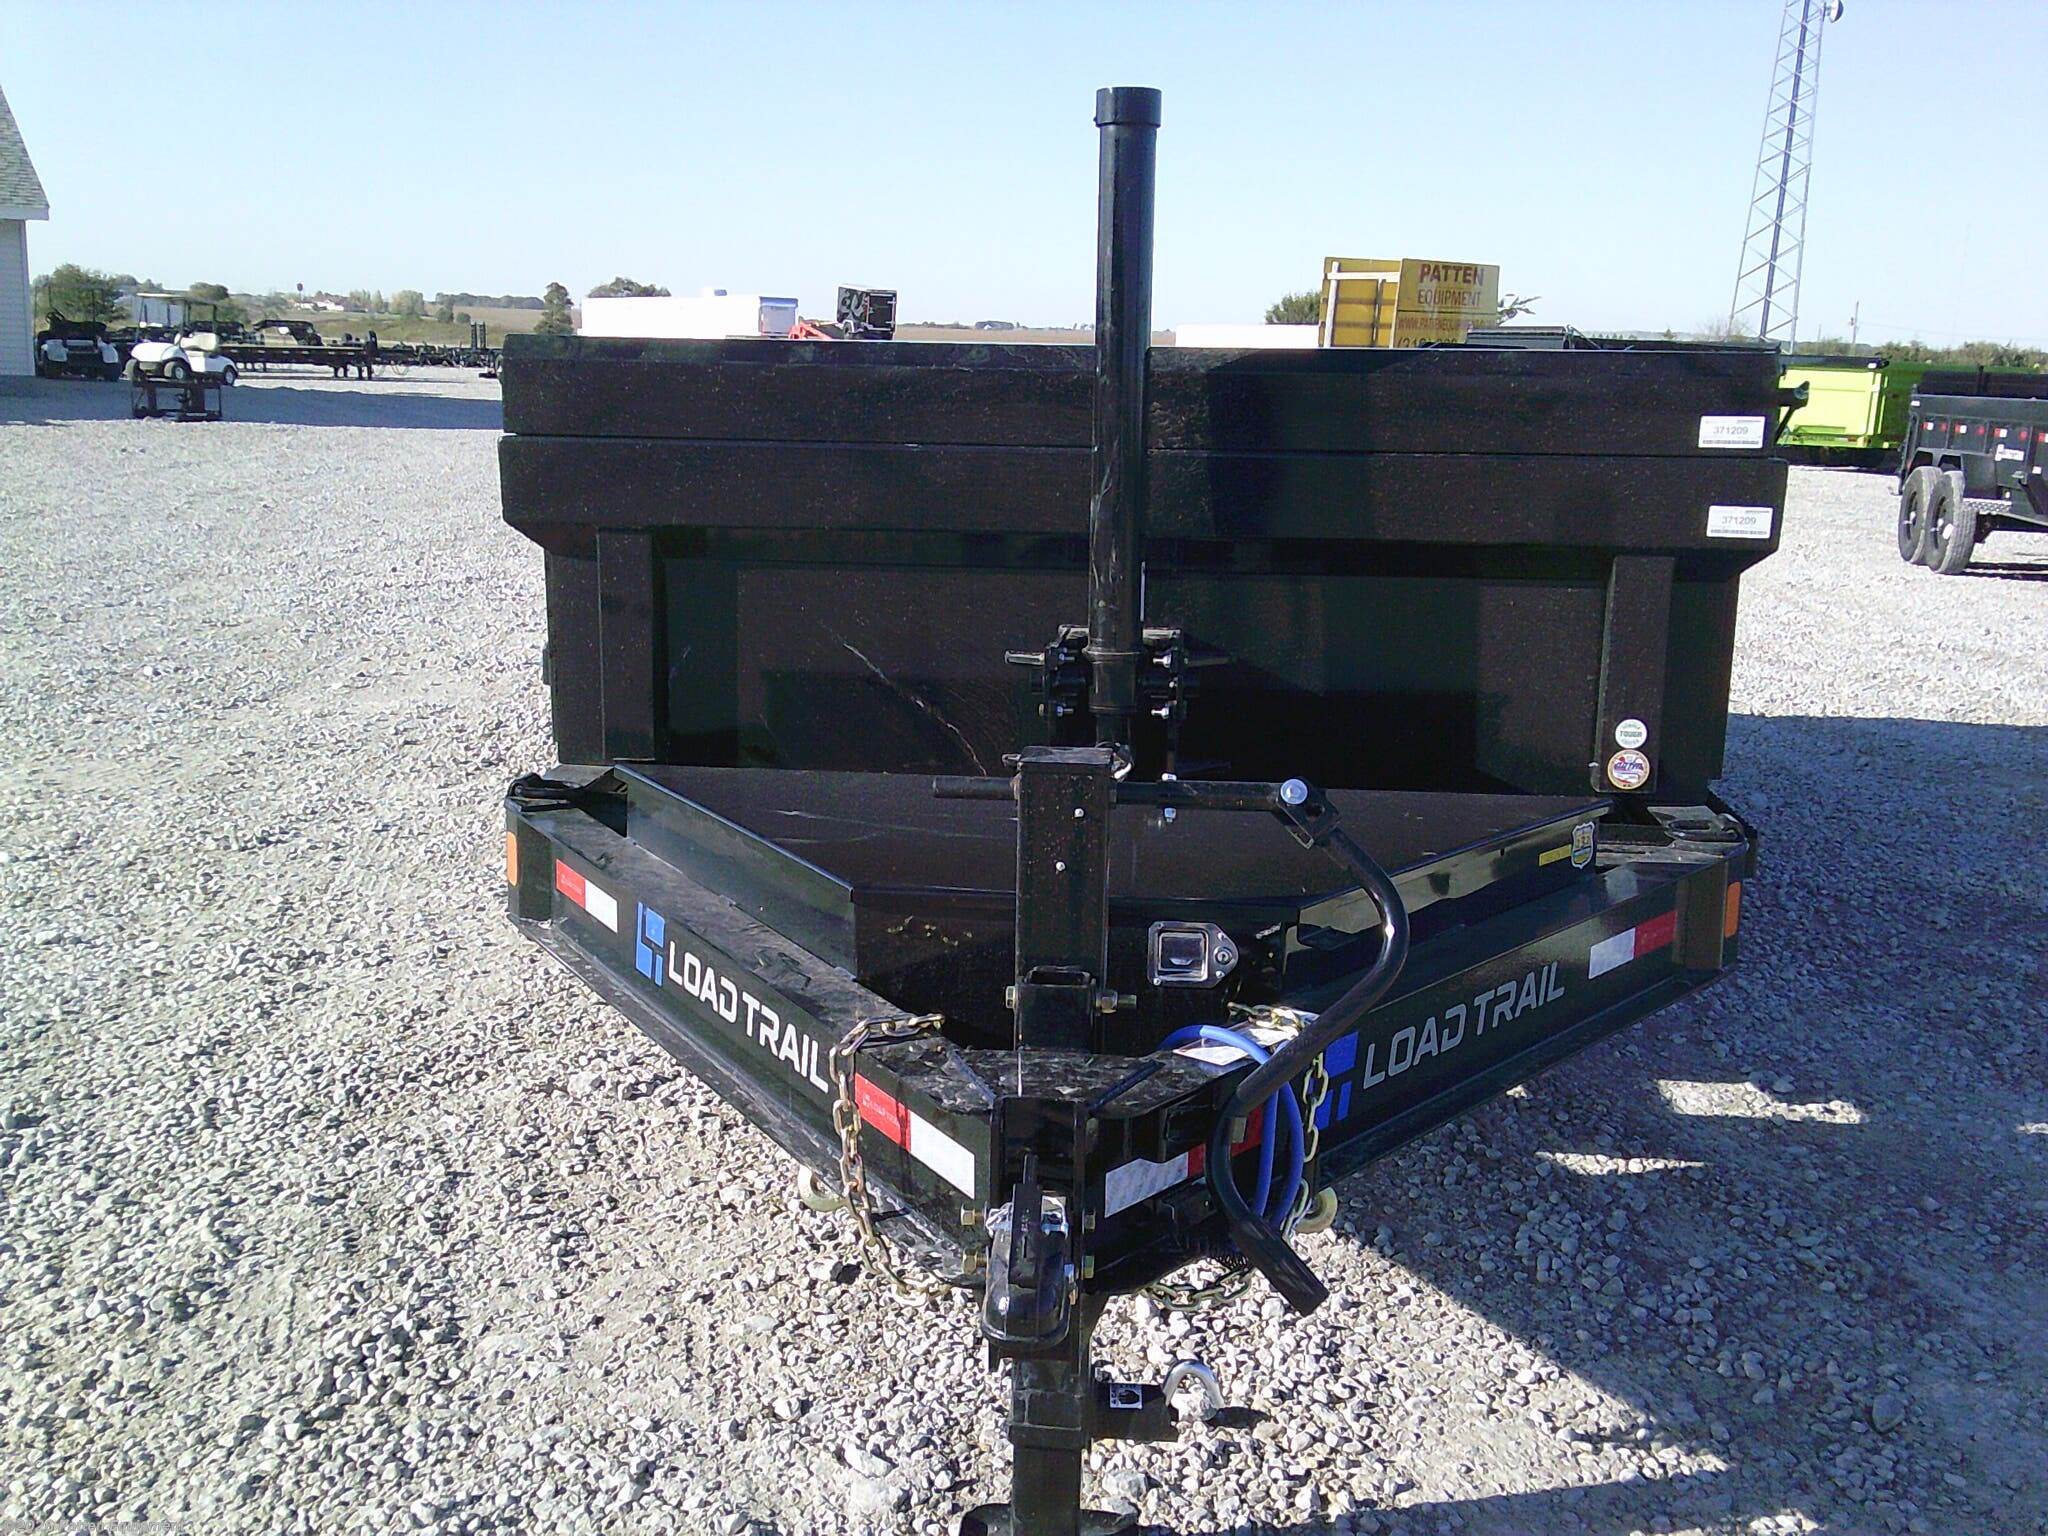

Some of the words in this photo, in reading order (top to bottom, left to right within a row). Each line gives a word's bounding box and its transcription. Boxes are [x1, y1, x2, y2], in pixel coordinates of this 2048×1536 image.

[1419, 263, 1484, 286] PATTEN
[1417, 288, 1481, 307] EQUIPMENT
[1712, 425, 1749, 435] 371209
[1721, 515, 1757, 525] 371209
